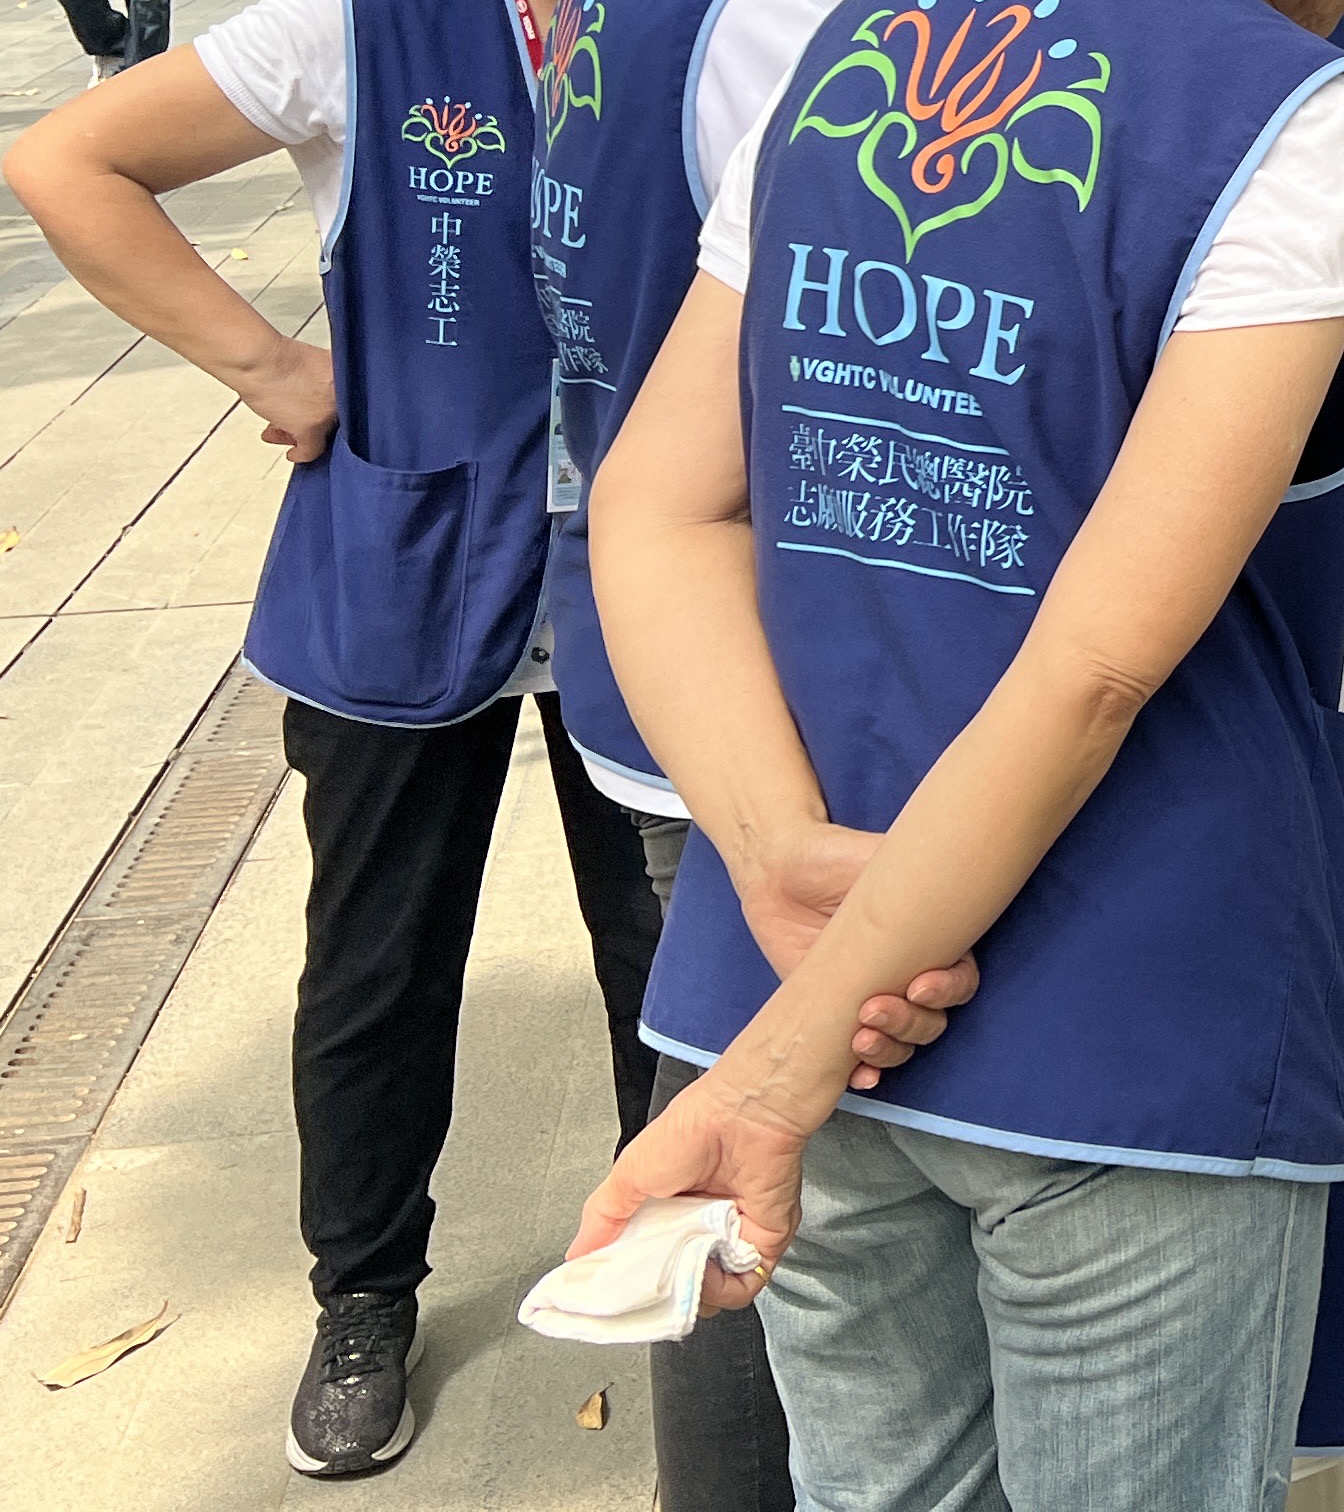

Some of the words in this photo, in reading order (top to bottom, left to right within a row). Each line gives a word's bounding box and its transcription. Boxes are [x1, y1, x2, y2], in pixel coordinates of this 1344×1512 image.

[408, 166, 494, 195] HOPE
[424, 212, 462, 348] 中榮志工
[783, 242, 1036, 386] HOPE
[802, 357, 876, 389] VGHTC
